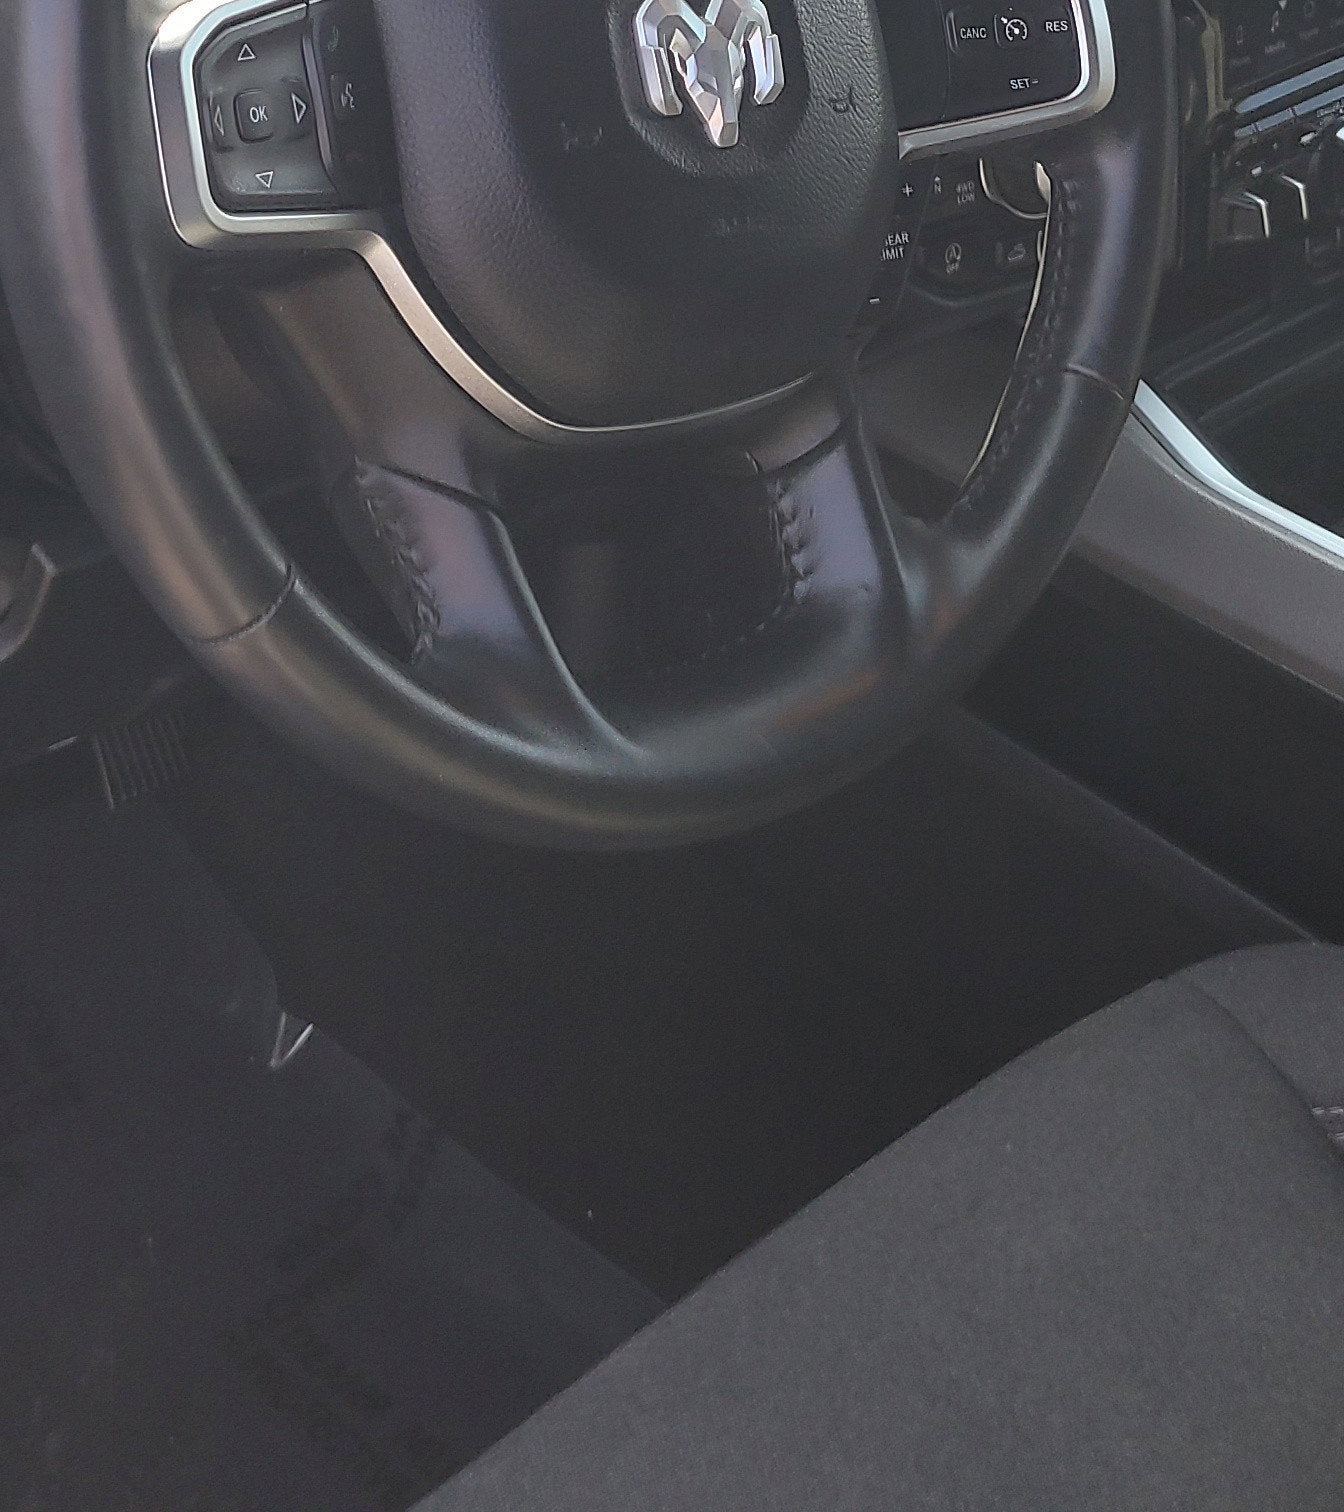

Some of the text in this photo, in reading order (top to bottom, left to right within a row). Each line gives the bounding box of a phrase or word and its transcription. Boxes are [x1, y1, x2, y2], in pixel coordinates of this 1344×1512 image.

[960, 26, 987, 41] CANC
[1045, 20, 1069, 33] RES
[249, 106, 268, 123] OK
[880, 246, 905, 262] IMIT
